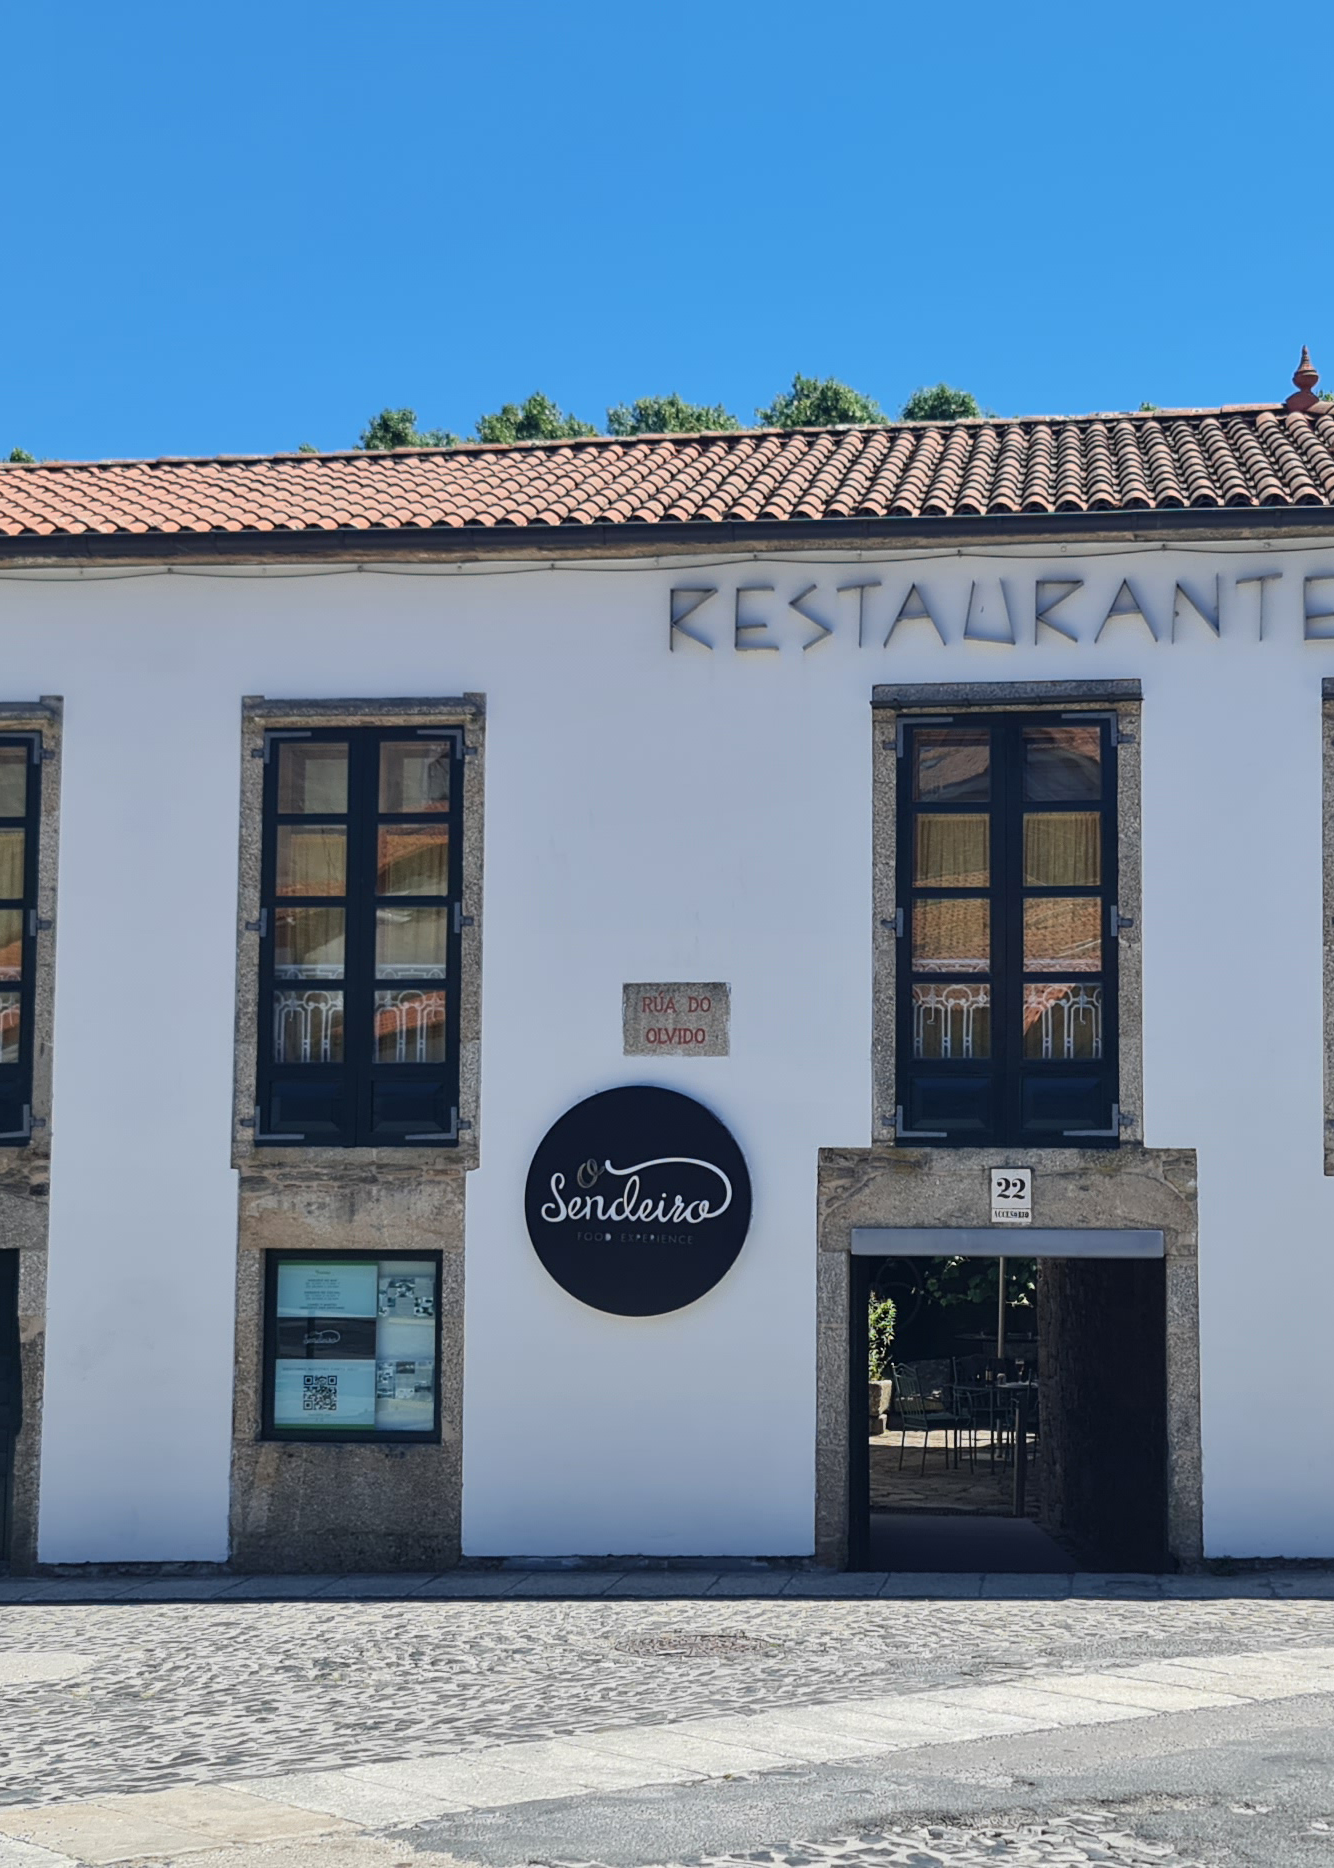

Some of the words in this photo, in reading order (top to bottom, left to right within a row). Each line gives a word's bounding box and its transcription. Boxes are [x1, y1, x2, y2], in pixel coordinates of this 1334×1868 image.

[641, 991, 677, 1013] RÚA
[687, 996, 711, 1013] DO
[646, 1027, 705, 1045] OLVIDO
[541, 1157, 733, 1224] Sendeiro
[996, 1177, 1026, 1200] 22
[576, 1231, 612, 1242] FOOD
[620, 1232, 695, 1245] EXPERIENCE
